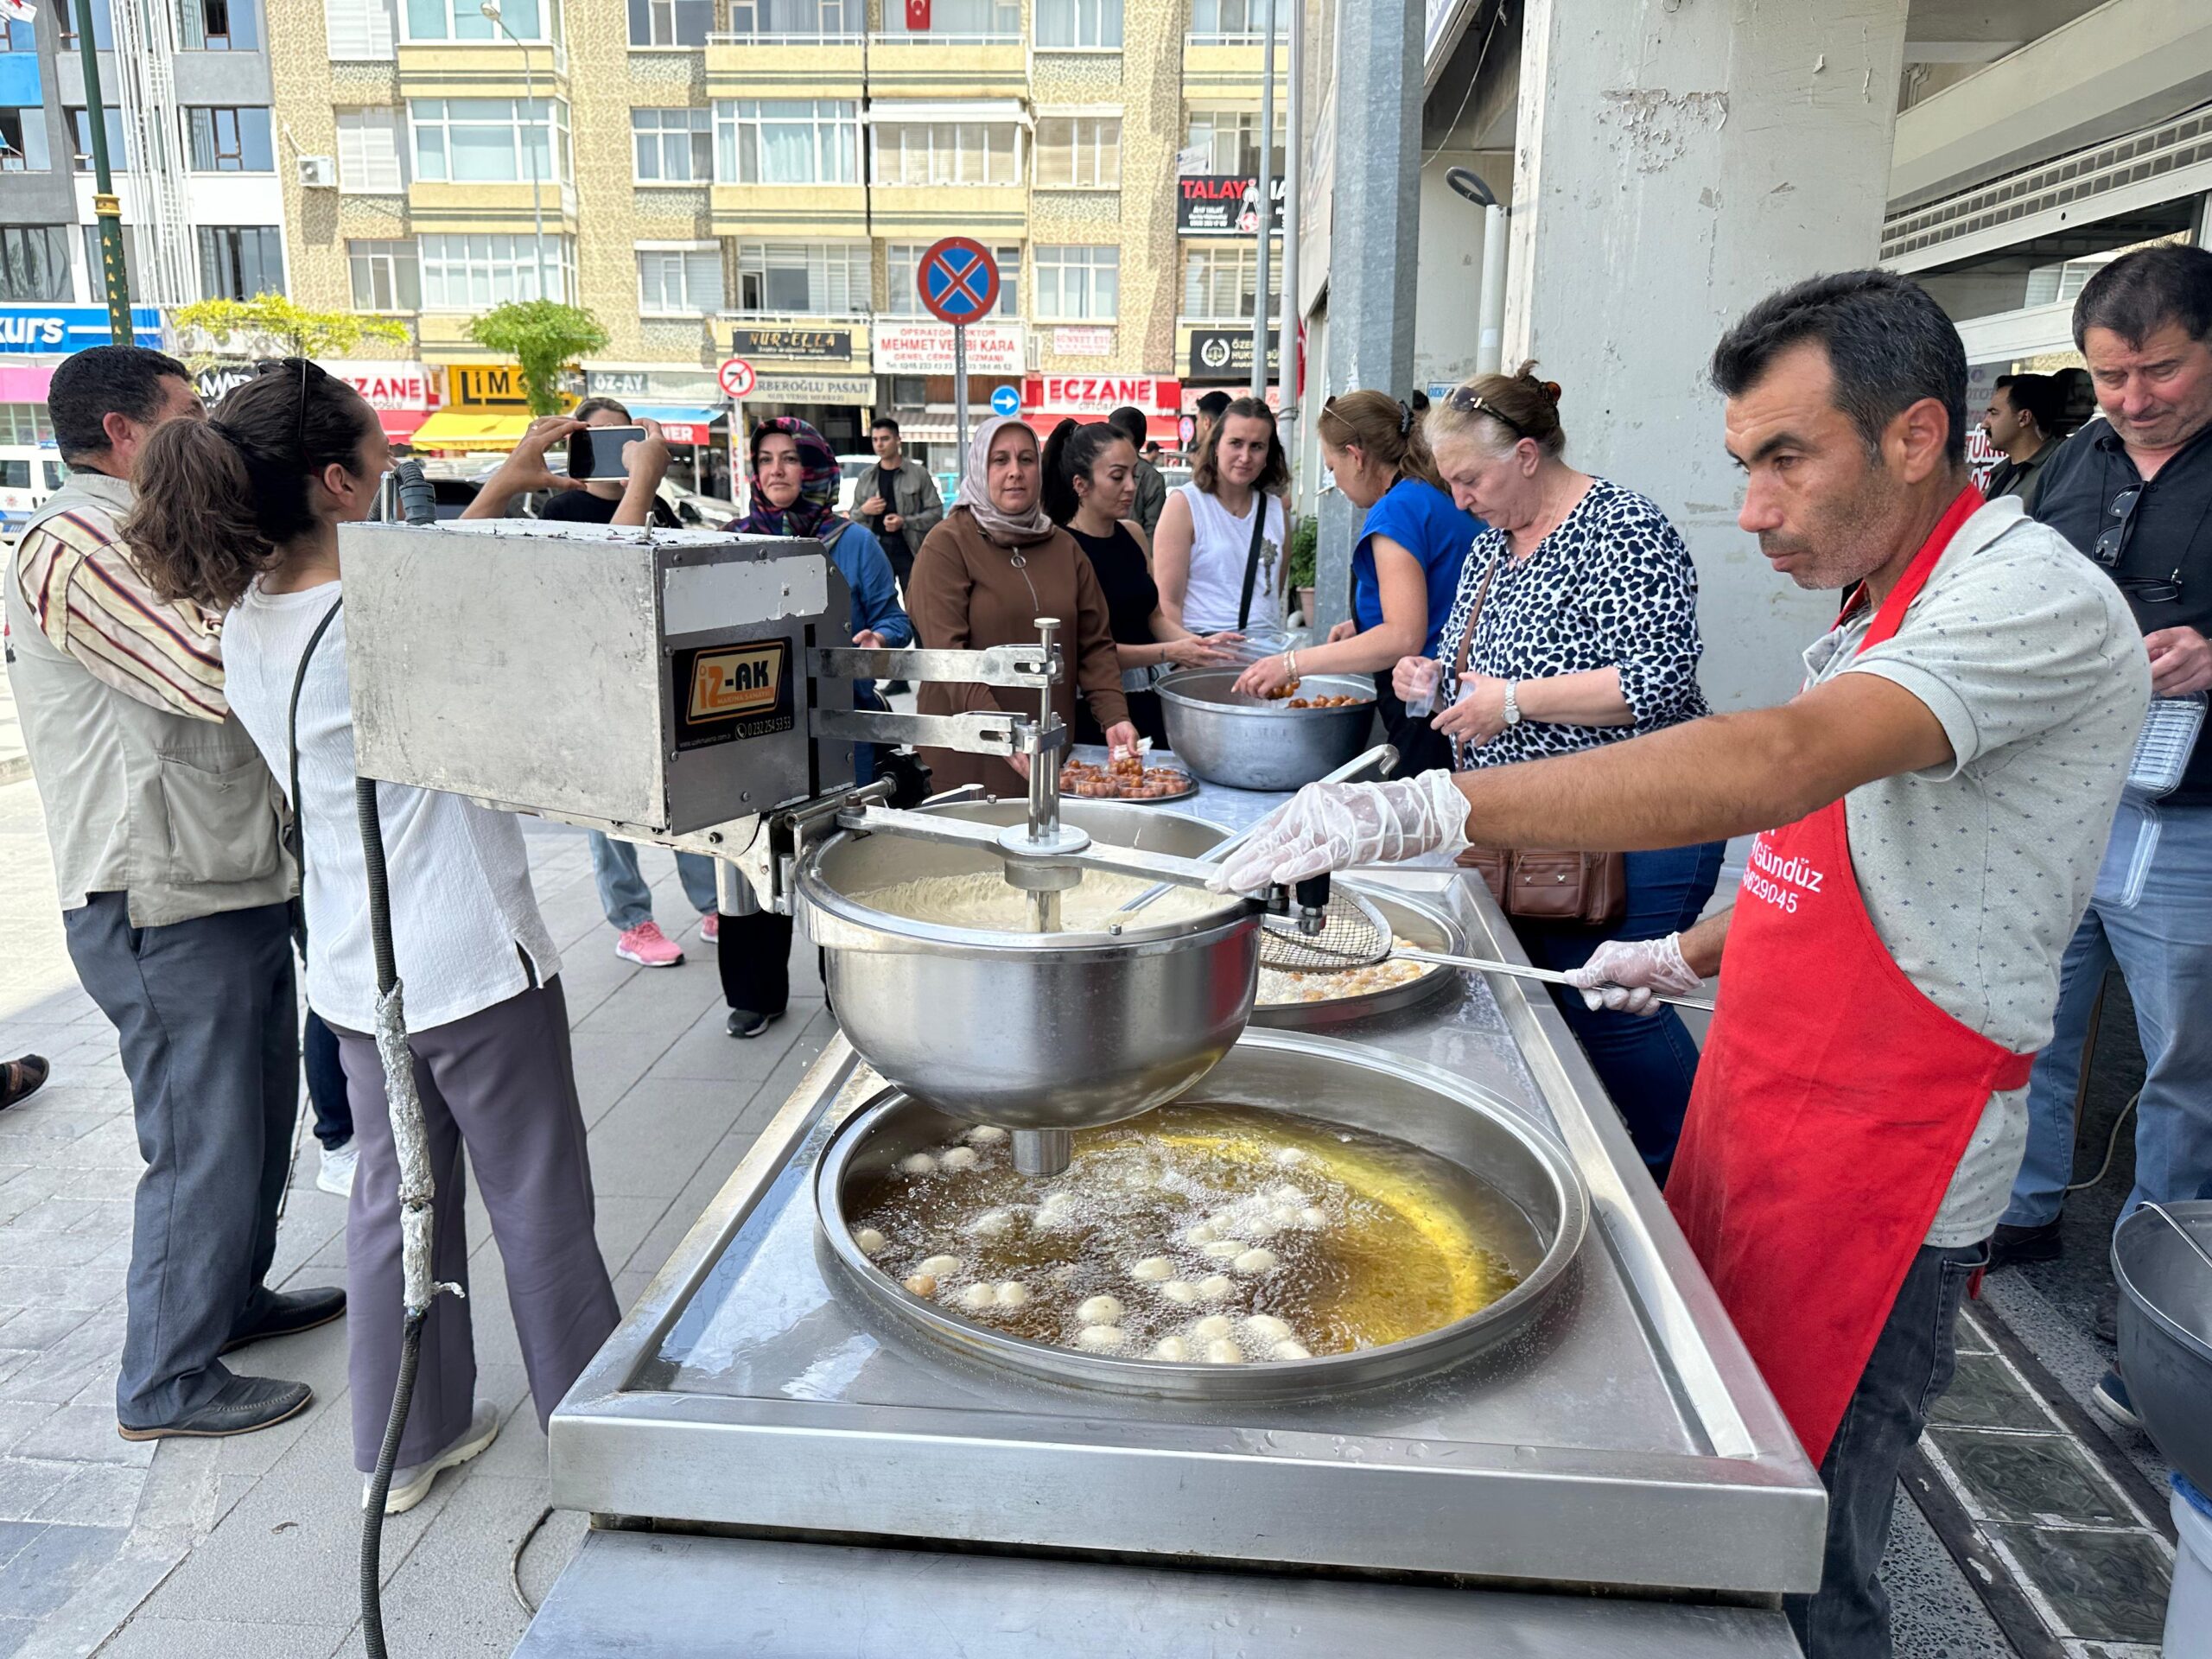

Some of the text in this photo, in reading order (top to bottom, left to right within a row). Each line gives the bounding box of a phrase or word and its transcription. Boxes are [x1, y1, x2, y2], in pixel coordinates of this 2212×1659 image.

[1181, 180, 1248, 200] TALAY
[963, 328, 996, 337] OKTOR
[880, 338, 1015, 352] MEHMET VEBİ KARA
[1231, 338, 1255, 349] ÖZE
[340, 378, 421, 400] ZANE
[754, 378, 824, 392] RBEROĞLU
[1049, 379, 1152, 402] ECZANE
